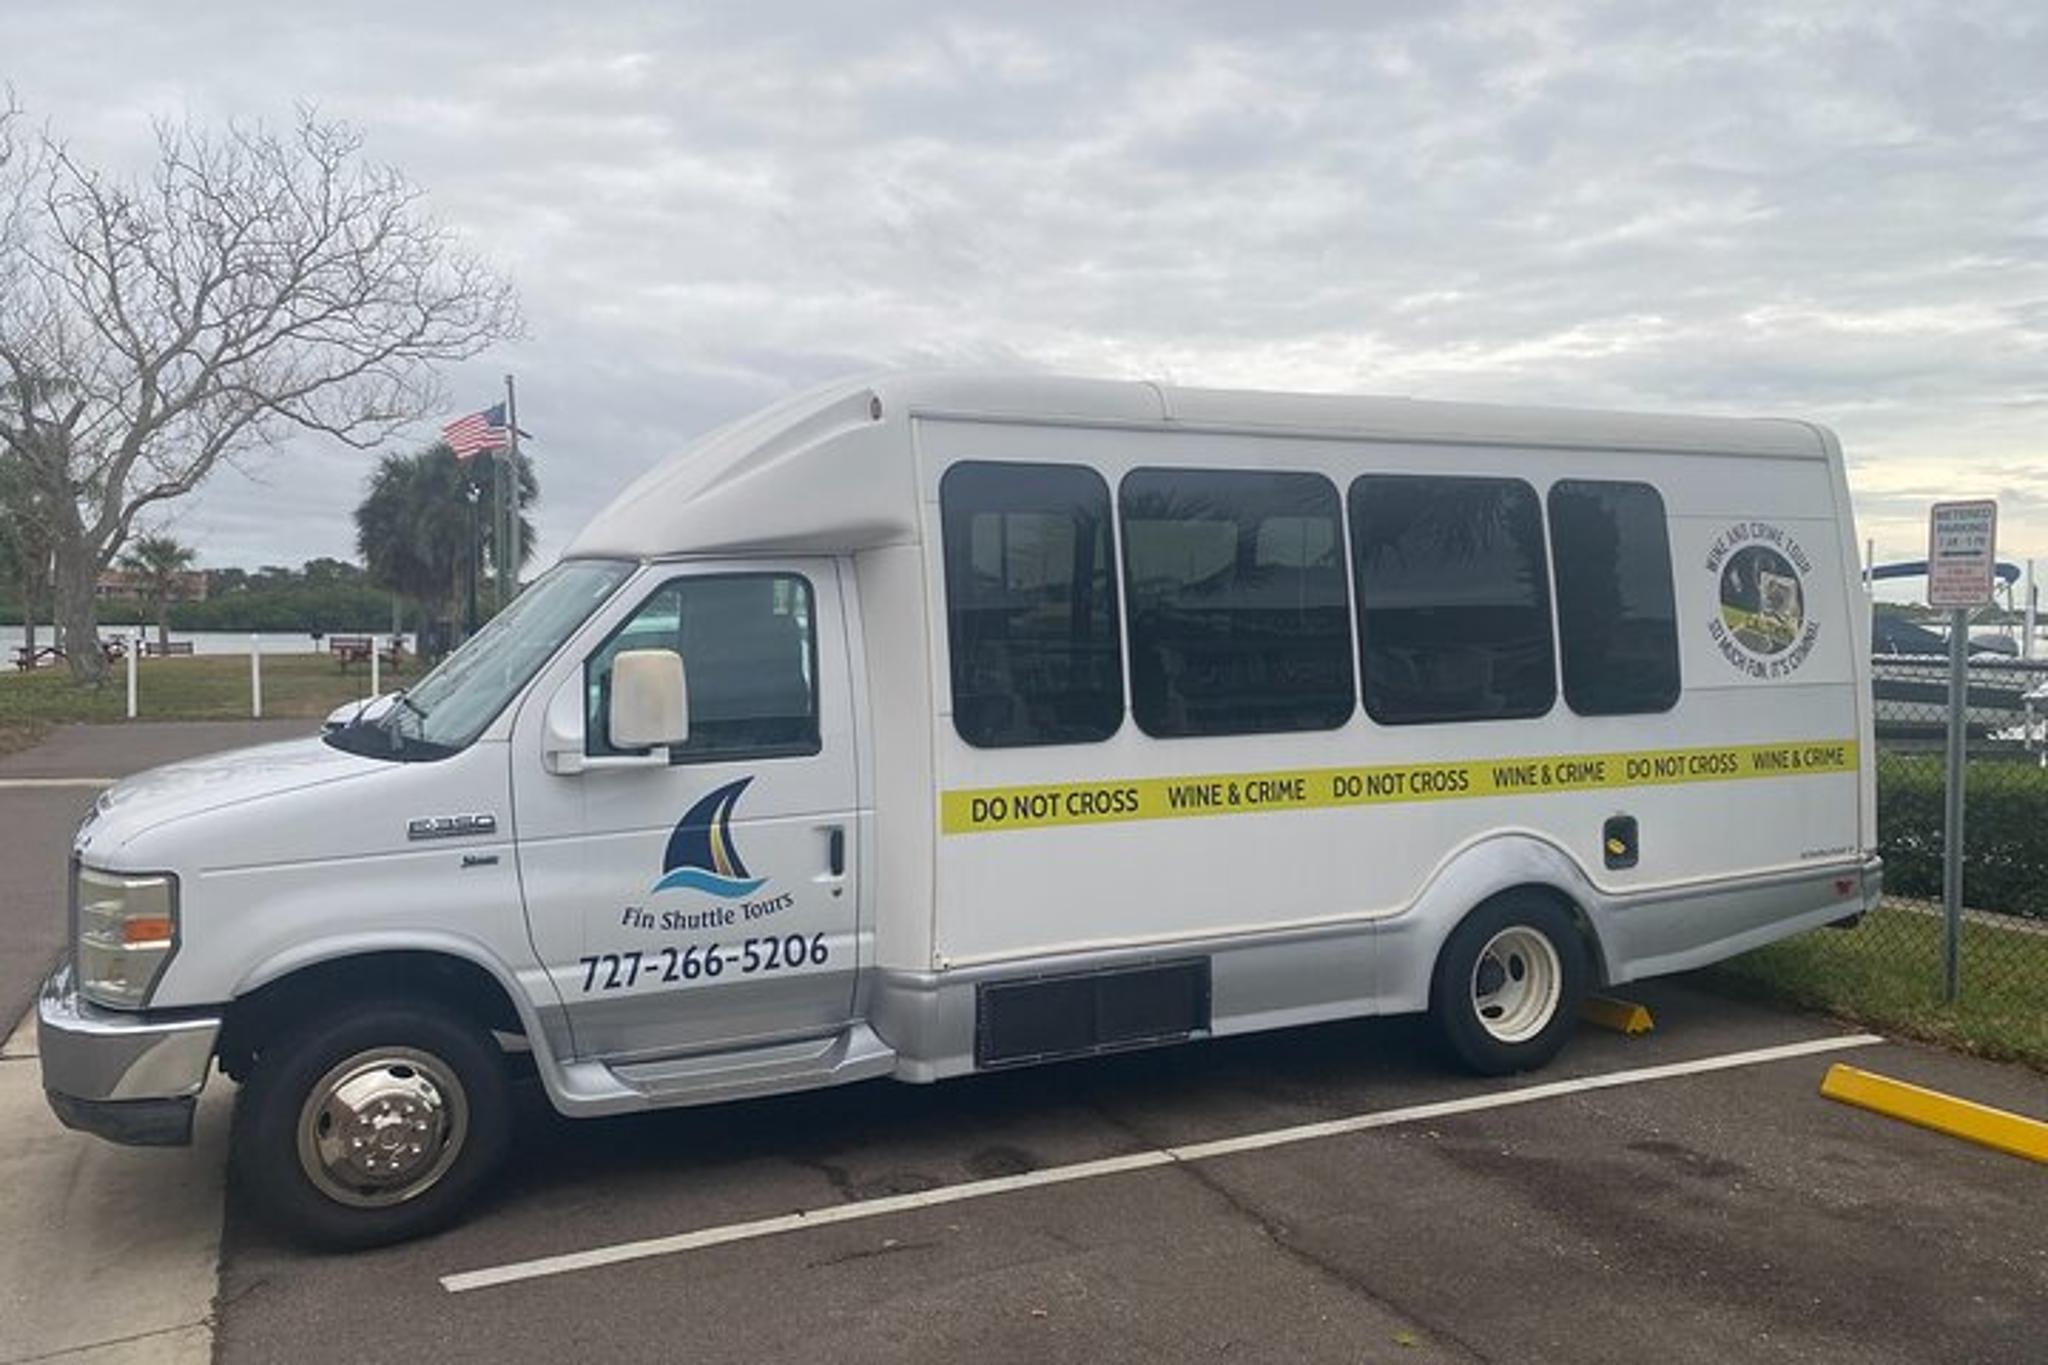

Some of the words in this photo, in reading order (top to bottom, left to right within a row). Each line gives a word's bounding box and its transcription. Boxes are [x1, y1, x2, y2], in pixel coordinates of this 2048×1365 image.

[1936, 522, 1989, 534] PARKING
[1706, 537, 1728, 573] WINE
[1726, 523, 1750, 544] AND
[1751, 522, 1785, 547] CRIME
[1708, 619, 1725, 641] SO
[1718, 633, 1748, 671] MUCH
[1626, 758, 1650, 780] DO
[1654, 756, 1686, 778] NOT
[1688, 752, 1738, 775] CROSS
[1752, 750, 1789, 771] WINE
[1792, 750, 1801, 768] &
[1803, 746, 1845, 767] CRIME
[1333, 775, 1362, 798] DO
[1367, 772, 1406, 796] NOT
[1410, 769, 1469, 794] CROSS
[1493, 766, 1537, 788] WINE
[1541, 764, 1552, 785] &
[1557, 761, 1605, 783] CRIME
[972, 797, 1008, 823] DO
[1013, 793, 1061, 820] NOT
[1066, 788, 1139, 817] CROSS
[1168, 783, 1222, 809] WINE
[1227, 782, 1241, 806] &
[1245, 778, 1306, 804] CRIME
[621, 906, 654, 930] Fin
[660, 906, 736, 931] Shuttle
[741, 892, 795, 920] Tours
[579, 932, 829, 993] 727-266-5206
